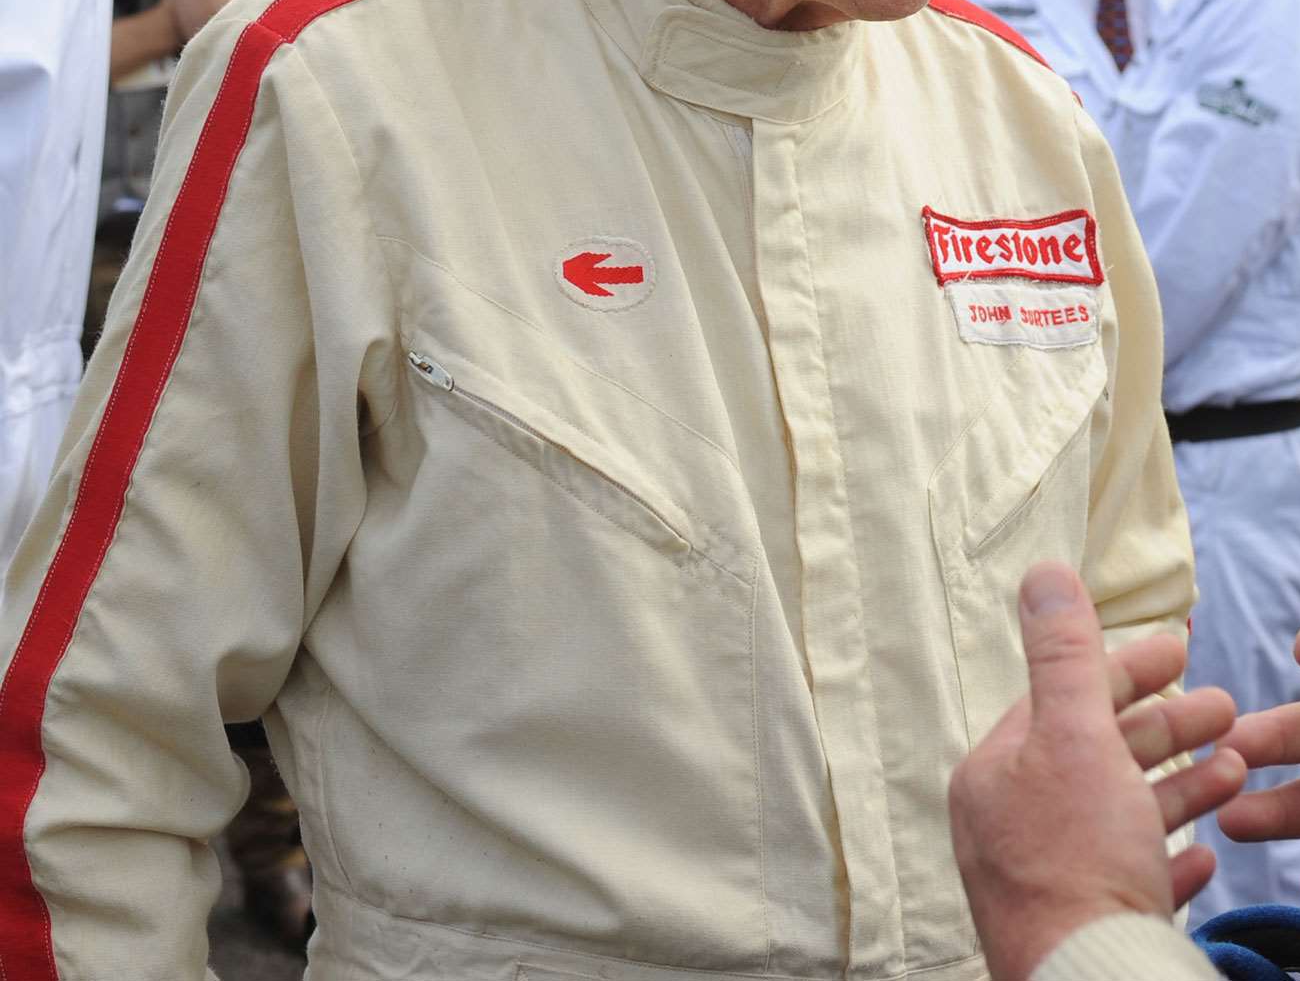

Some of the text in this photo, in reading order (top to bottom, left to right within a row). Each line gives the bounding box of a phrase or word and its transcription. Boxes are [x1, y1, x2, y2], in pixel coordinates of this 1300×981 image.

[933, 223, 1084, 266] Firestone
[968, 304, 1090, 328] JOHN SURTEES
